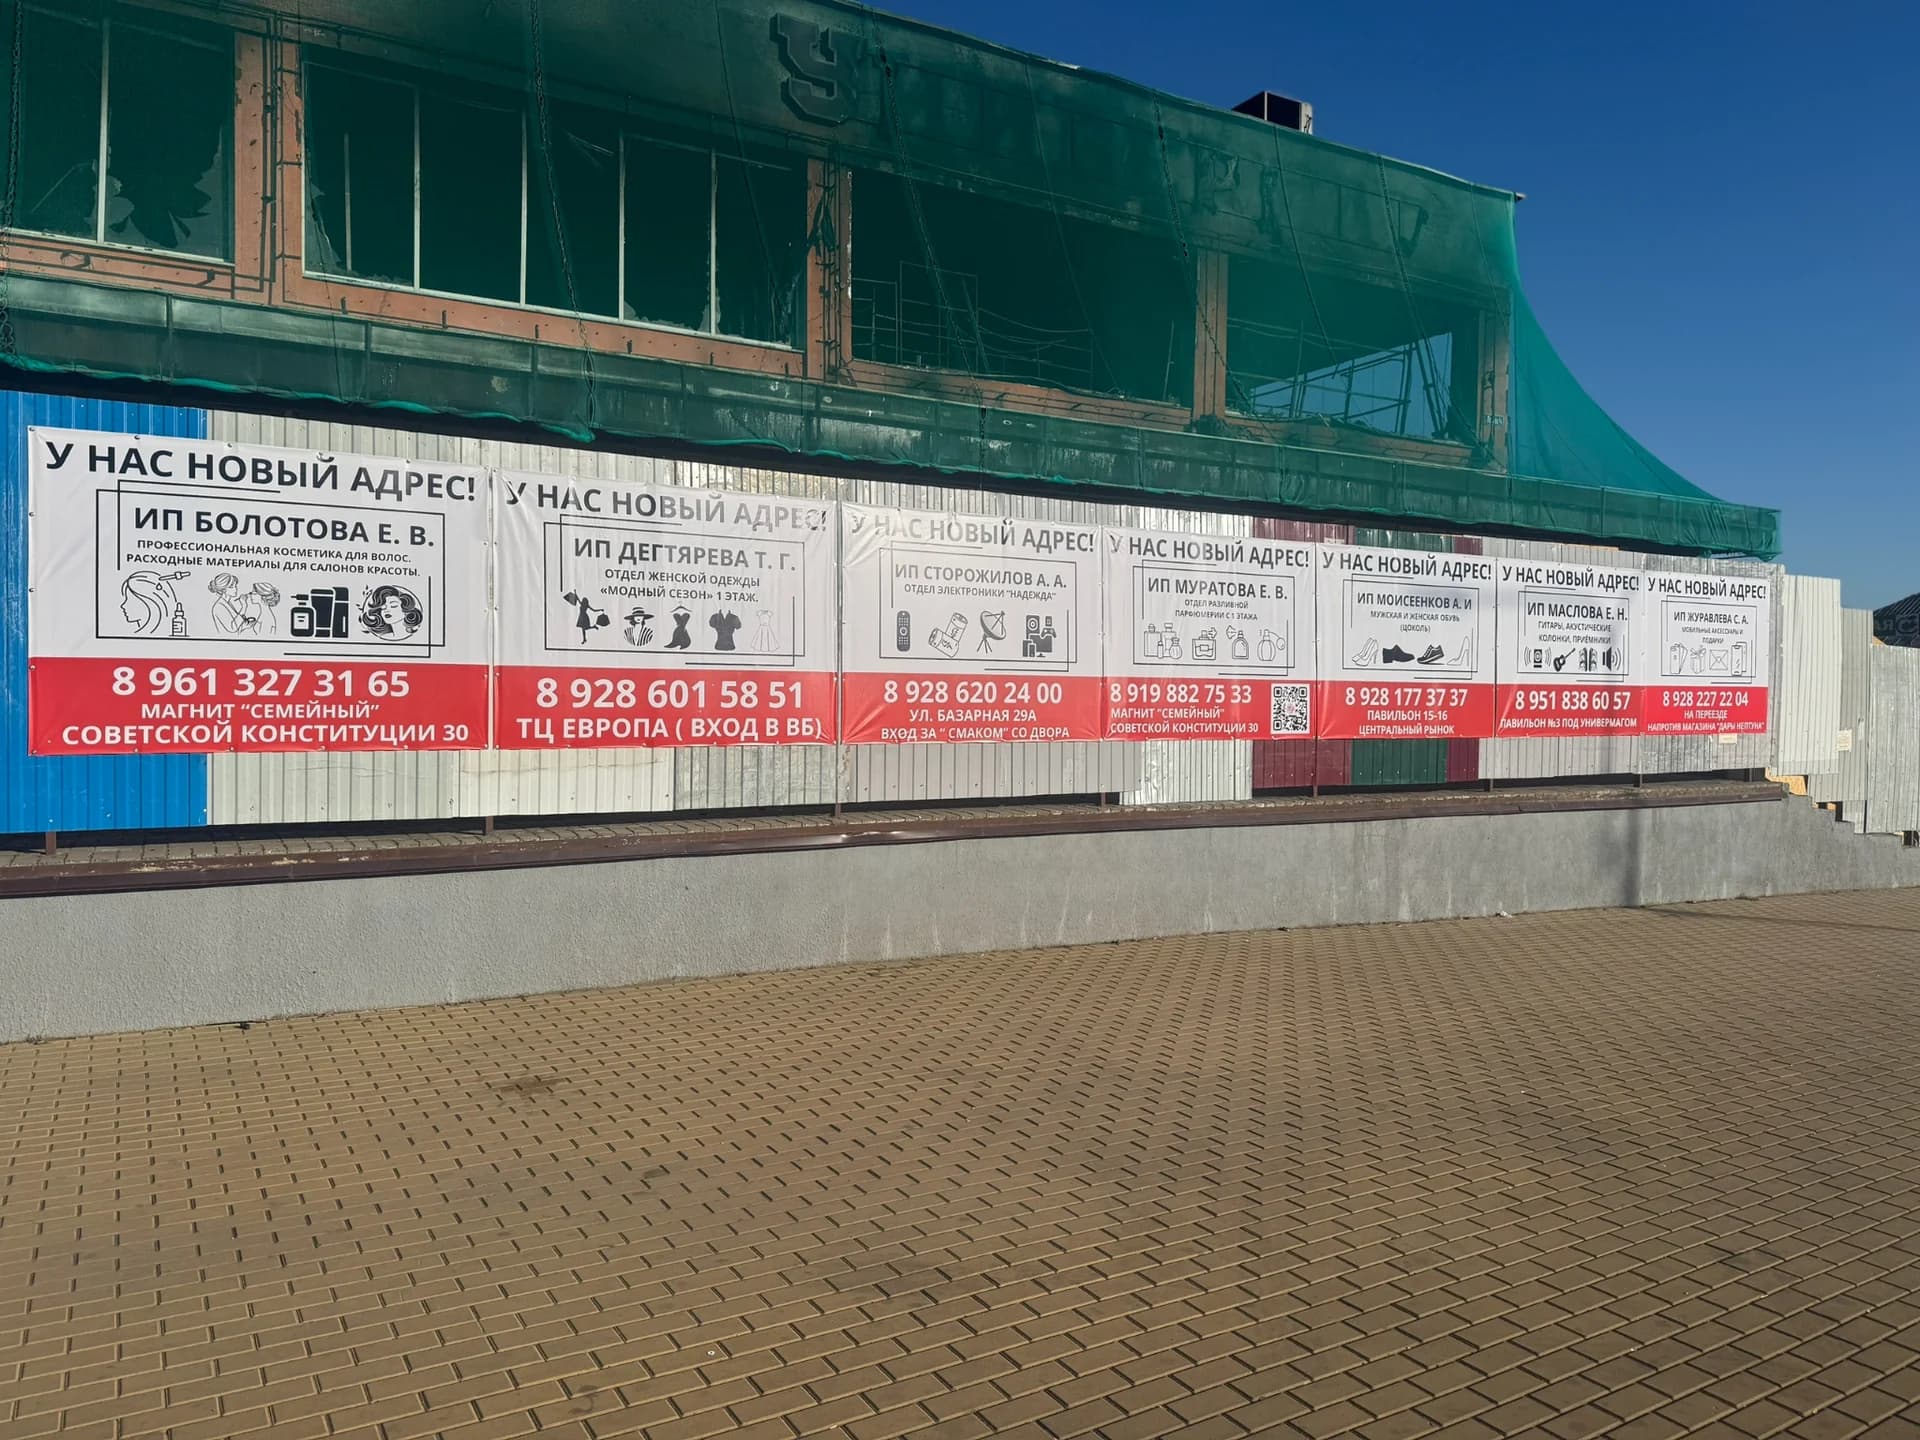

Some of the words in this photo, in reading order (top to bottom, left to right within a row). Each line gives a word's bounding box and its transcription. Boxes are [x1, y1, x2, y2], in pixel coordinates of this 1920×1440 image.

[46, 441, 74, 471] У
[88, 444, 173, 478] НАС
[189, 451, 338, 490] НОВЫЙ
[351, 466, 476, 501] АДРЕС!
[505, 480, 527, 505] У
[538, 484, 601, 513] НАС
[613, 491, 725, 523] НОВЫЙ
[734, 503, 826, 533] АДРЕС!
[134, 508, 183, 531] ИП
[196, 512, 369, 543] БОЛОТОВА
[379, 523, 401, 545] Е.
[410, 526, 435, 547] В.
[852, 515, 866, 533] У
[875, 515, 922, 539] НАС
[930, 519, 1015, 546] НОВЫЙ
[1023, 528, 1095, 554] АДРЕС!
[137, 540, 270, 555] ПРОФЕССИОНАЛЬНАЯ
[273, 547, 343, 560] КОСМЕТИКА
[345, 551, 368, 562] ДЛЯ
[371, 552, 412, 563] ВОЛОС.
[574, 538, 610, 558] ИП
[618, 541, 749, 569] ДЕГТЯРЕВА
[755, 552, 772, 570] Т.
[780, 553, 795, 571] Г.
[1129, 537, 1167, 557] НАС
[1174, 540, 1244, 563] НОВЫЙ
[1249, 547, 1309, 569] АДРЕС!
[126, 553, 202, 567] РАСХОДНЫЕ
[205, 558, 281, 571] МАТЕРИАЛЫ
[283, 560, 308, 572] ДЛЯ
[310, 563, 364, 574] САЛОНОВ
[367, 566, 420, 577] КРАСОТЫ.
[1323, 552, 1335, 568] У
[1340, 553, 1373, 572] НАС
[1378, 555, 1437, 576] НОВЫЙ
[1442, 561, 1491, 582] АДРЕС!
[605, 569, 645, 582] ОТДЕЛ
[648, 570, 707, 585] ЖЕНСКОЙ
[709, 576, 760, 588] ОДЕЖДЫ
[896, 564, 918, 579] ИП
[924, 565, 1033, 585] СТОРОЖИЛОВ
[1037, 574, 1050, 587] А.
[1054, 575, 1067, 588] А.
[1502, 566, 1512, 581] У
[1516, 567, 1542, 583] НАС
[1547, 569, 1594, 587] НОВЫЙ
[1598, 573, 1639, 592] АДРЕС!
[600, 585, 666, 598] «МОДНЫЙ
[669, 589, 713, 601] СЕЗОН»
[716, 592, 722, 601] 1
[725, 592, 759, 602] ЭТАЖ.
[904, 584, 935, 594] ОТДЕЛ
[938, 586, 1005, 597] ЭЛЕКТРОНИКИ
[1149, 578, 1170, 593] ИП
[1175, 580, 1256, 598] МУРАТОВА
[1260, 585, 1271, 599] Е.
[1275, 586, 1288, 600] В.
[1648, 577, 1656, 591] У
[1659, 578, 1682, 593] НАС
[1685, 579, 1727, 596] НОВЫЙ
[1730, 583, 1766, 601] АДРЕС!
[1184, 599, 1207, 607] ОТДЕЛ
[1208, 600, 1249, 609] РАЗЛИВНОЙ
[1358, 593, 1374, 604] ИП
[1377, 594, 1450, 609] МОИСЕЕНКОВ
[1452, 599, 1462, 609] А.
[1464, 599, 1472, 610] И
[1371, 611, 1401, 619] МУЖСКАЯ
[1410, 613, 1438, 621] ЖЕНСКАЯ
[1440, 614, 1460, 622] ОБУВЬ
[1528, 602, 1544, 616] ИП
[1549, 604, 1603, 619] МАСЛОВА
[1606, 607, 1614, 620] Е.
[1618, 608, 1628, 621] Н.
[1674, 612, 1686, 621] ИП
[1687, 612, 1732, 624] ЖУРАВЛЕВА
[1734, 615, 1740, 624] С.
[1742, 615, 1749, 625] А.
[112, 666, 136, 695] 8
[149, 668, 217, 696] 961
[233, 669, 302, 697] 327
[314, 670, 353, 697] 31
[367, 671, 410, 697] 65
[536, 678, 558, 707] 8
[570, 679, 636, 708] 928
[647, 680, 706, 708] 601
[721, 681, 758, 709] 58
[768, 682, 802, 709] 51
[884, 680, 898, 703] 8
[905, 680, 949, 703] 928
[956, 682, 997, 703] 620
[1004, 683, 1030, 703] 24
[1037, 683, 1062, 703] 00
[1110, 684, 1122, 702] 8
[1127, 684, 1161, 703] 919
[1167, 684, 1199, 703] 882
[1205, 685, 1225, 703] 75
[1230, 685, 1251, 703] 33
[1345, 687, 1355, 705] 8
[1360, 687, 1389, 705] 928
[1394, 688, 1421, 706] 177
[1426, 688, 1446, 706] 37
[1449, 689, 1467, 706] 37
[1515, 691, 1525, 710] 8
[1529, 691, 1556, 710] 951
[1561, 691, 1588, 710] 838
[1592, 692, 1609, 710] 60
[1613, 692, 1631, 710] 57
[1663, 691, 1670, 706] 8
[1673, 691, 1693, 706] 928
[1697, 692, 1716, 706] 227
[1720, 692, 1732, 706] 22
[1736, 692, 1748, 706] 04
[141, 704, 234, 720] МАГНИТ
[909, 709, 933, 722] УЛ.
[937, 709, 1009, 722] БАЗАРНАЯ
[1013, 710, 1037, 721] 29А
[1111, 708, 1154, 718] МАГНИТ
[1368, 710, 1421, 720] ПАВИЛЬОН
[1423, 711, 1447, 720] 15-16
[1684, 710, 1694, 718] НА
[1696, 710, 1727, 720] ПЕРЕЕЗДЕ
[516, 718, 554, 742] ТЦ
[563, 718, 668, 738] ЕВРОПА
[691, 719, 758, 741] ВХОД
[765, 719, 779, 737] В
[1110, 721, 1169, 733] СОВЕТСКОЙ
[1172, 723, 1246, 735] КОНСТИТУЦИИ
[1248, 724, 1258, 732] 30
[1359, 724, 1421, 736] ЦЕНТРАЛЬНЫЙ
[1424, 725, 1454, 734] РЫНОК
[1500, 718, 1546, 728] ПАВИЛЬОН
[1562, 718, 1579, 729] ПОД
[1580, 718, 1637, 728] УНИВЕРМАГОМ
[1648, 723, 1681, 731] НАПРОТИВ
[1683, 722, 1716, 731] МАГАЗИНА
[62, 721, 233, 745] СОВЕТСКОЙ
[241, 725, 436, 747] КОНСТИТУЦИИ
[444, 726, 469, 742] 30
[881, 729, 917, 741] ВХОД
[921, 728, 936, 739] ЗА
[1012, 728, 1027, 738] СО
[1030, 728, 1070, 740] ДВОРА
